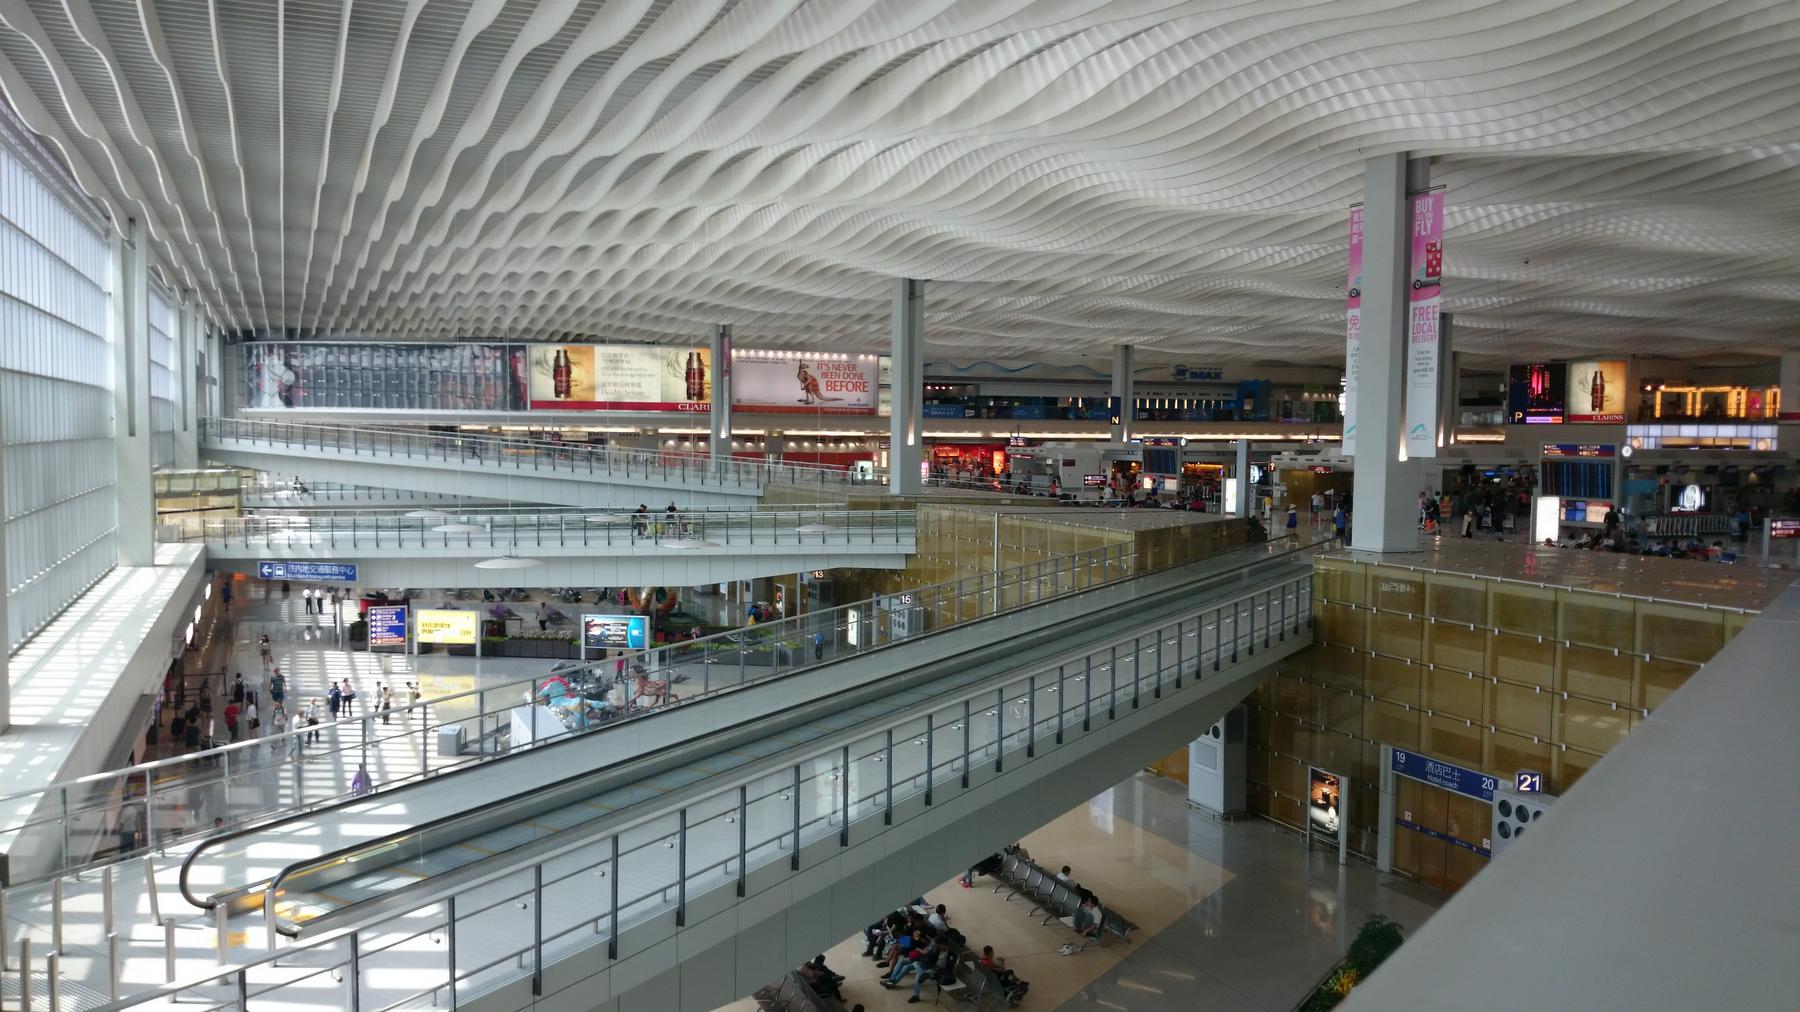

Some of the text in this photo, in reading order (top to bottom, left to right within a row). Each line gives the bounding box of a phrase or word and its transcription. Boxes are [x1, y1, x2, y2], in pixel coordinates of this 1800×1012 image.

[1416, 197, 1434, 214] BUY
[1415, 219, 1433, 236] FLY
[1412, 304, 1438, 322] FREE
[1412, 322, 1438, 335] LOCAL
[1411, 334, 1438, 344] DELIVERY
[817, 363, 858, 372] IT'S NEVER
[821, 372, 865, 380] BEEN DONE
[825, 380, 869, 393] BEFORE
[1111, 416, 1120, 425] N
[1515, 411, 1523, 422] P
[814, 570, 824, 579] 13
[900, 595, 911, 604] 15
[1396, 751, 1406, 763] 19
[1425, 761, 1461, 782] 酒店巴士
[1427, 774, 1459, 789] Hotel coach
[1481, 777, 1494, 791] 20
[1519, 774, 1540, 792] 21
